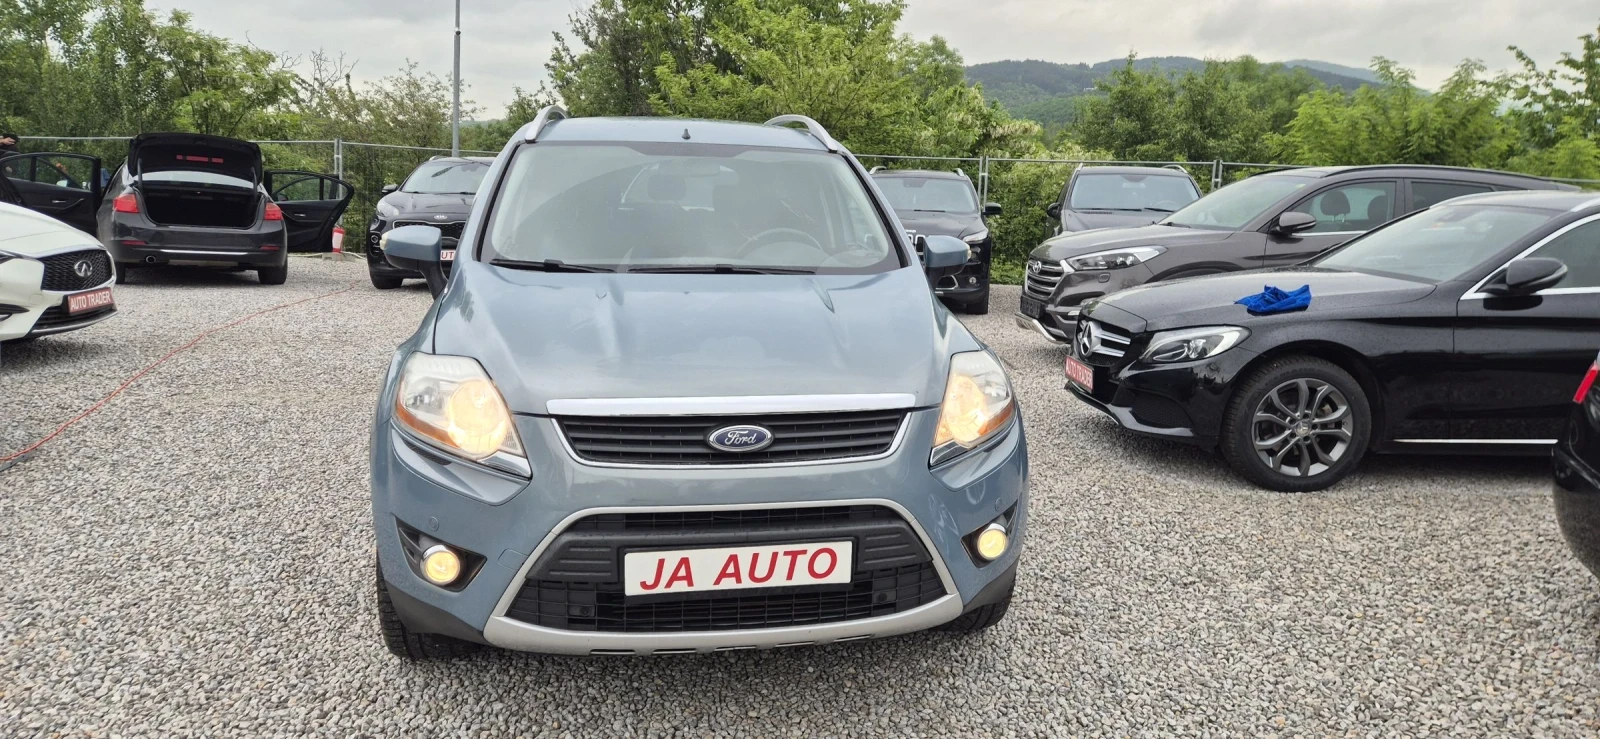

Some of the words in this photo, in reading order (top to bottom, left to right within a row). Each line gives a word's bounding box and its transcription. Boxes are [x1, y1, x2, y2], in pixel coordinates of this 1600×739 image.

[441, 251, 455, 260] UT
[70, 295, 87, 310] AUTO
[87, 290, 111, 306] TRADER
[724, 430, 758, 445] Ford
[639, 556, 695, 591] JA
[713, 547, 838, 586] AUTO
